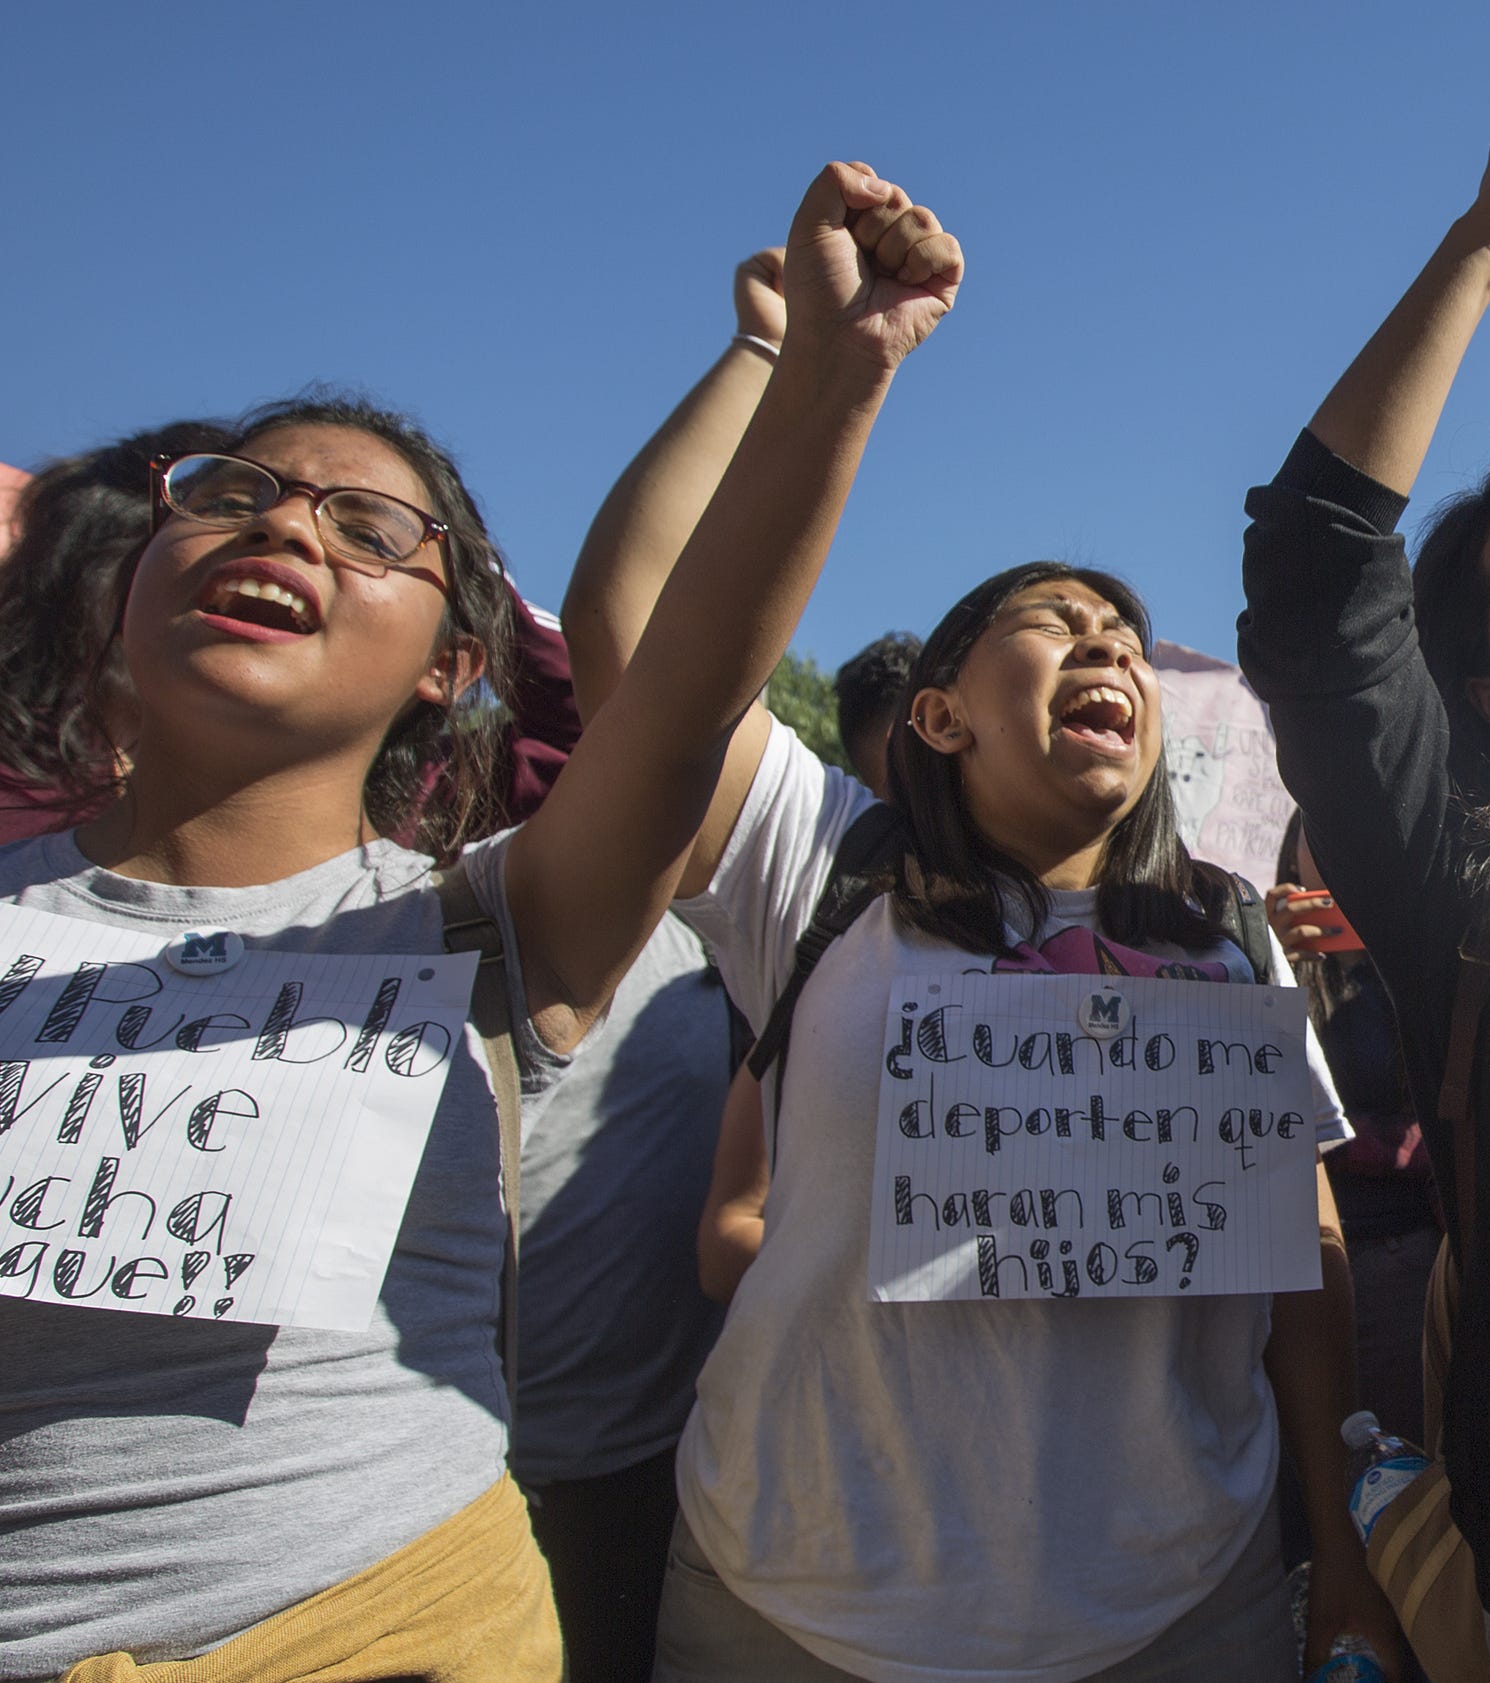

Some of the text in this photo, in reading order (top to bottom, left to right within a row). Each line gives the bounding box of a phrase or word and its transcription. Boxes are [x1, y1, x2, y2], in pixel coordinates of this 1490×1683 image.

[181, 931, 230, 957] M
[34, 961, 452, 1077] Pueblo
[1089, 994, 1122, 1023] M
[1198, 1038, 1283, 1076] me
[899, 1072, 1305, 1170] deporten que
[894, 1162, 1227, 1232] haran mis
[976, 1232, 1200, 1298] hijos?
